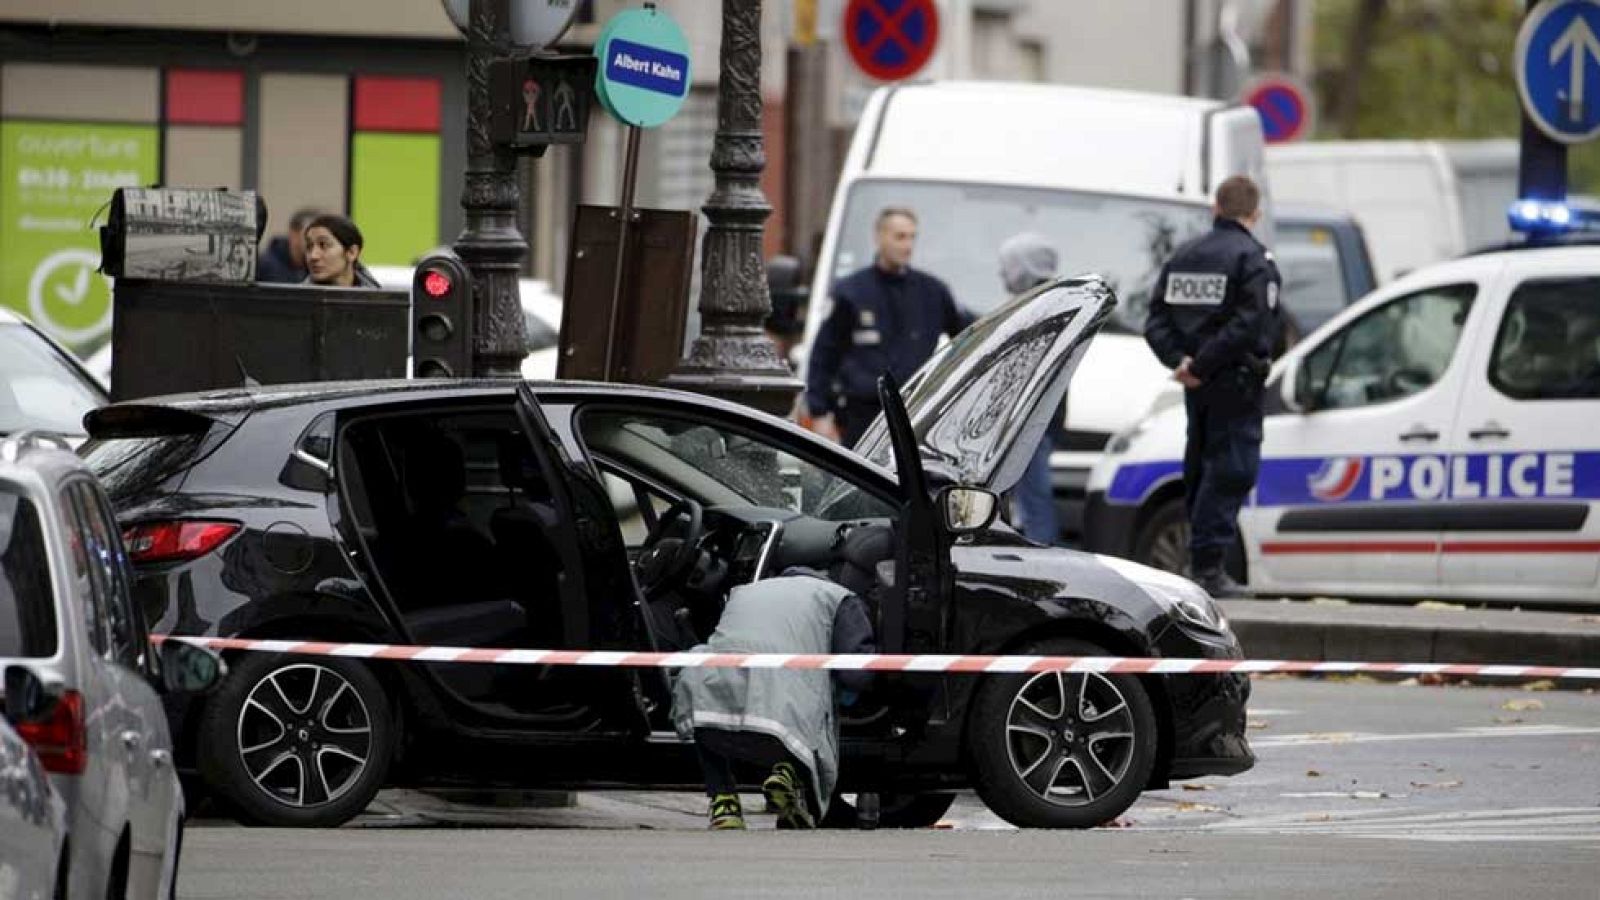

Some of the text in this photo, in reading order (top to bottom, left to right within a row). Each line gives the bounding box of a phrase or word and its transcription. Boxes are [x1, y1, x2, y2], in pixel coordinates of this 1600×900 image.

[614, 52, 682, 81] Albert Kahn
[1170, 278, 1225, 300] POLICE
[1369, 453, 1575, 501] POLICE
